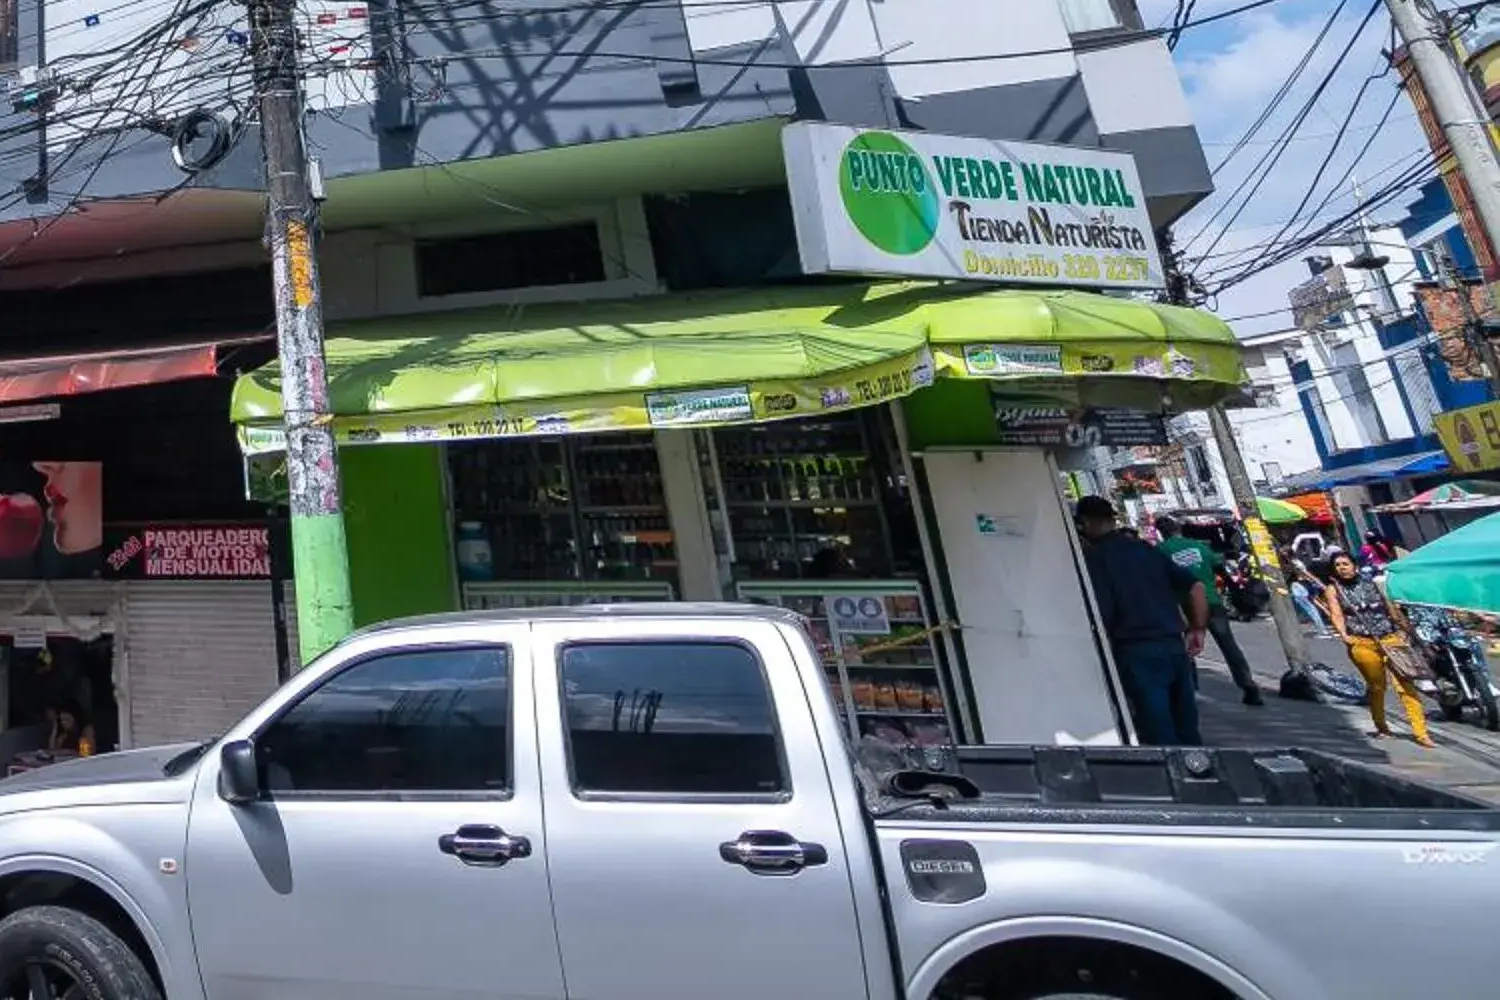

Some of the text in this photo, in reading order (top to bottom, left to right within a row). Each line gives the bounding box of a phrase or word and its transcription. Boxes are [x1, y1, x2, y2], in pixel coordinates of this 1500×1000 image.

[847, 150, 1136, 208] PUNTO VERDE NATURAL
[163, 547, 257, 560] DE MOTOS
[914, 860, 972, 873] DIESEL
